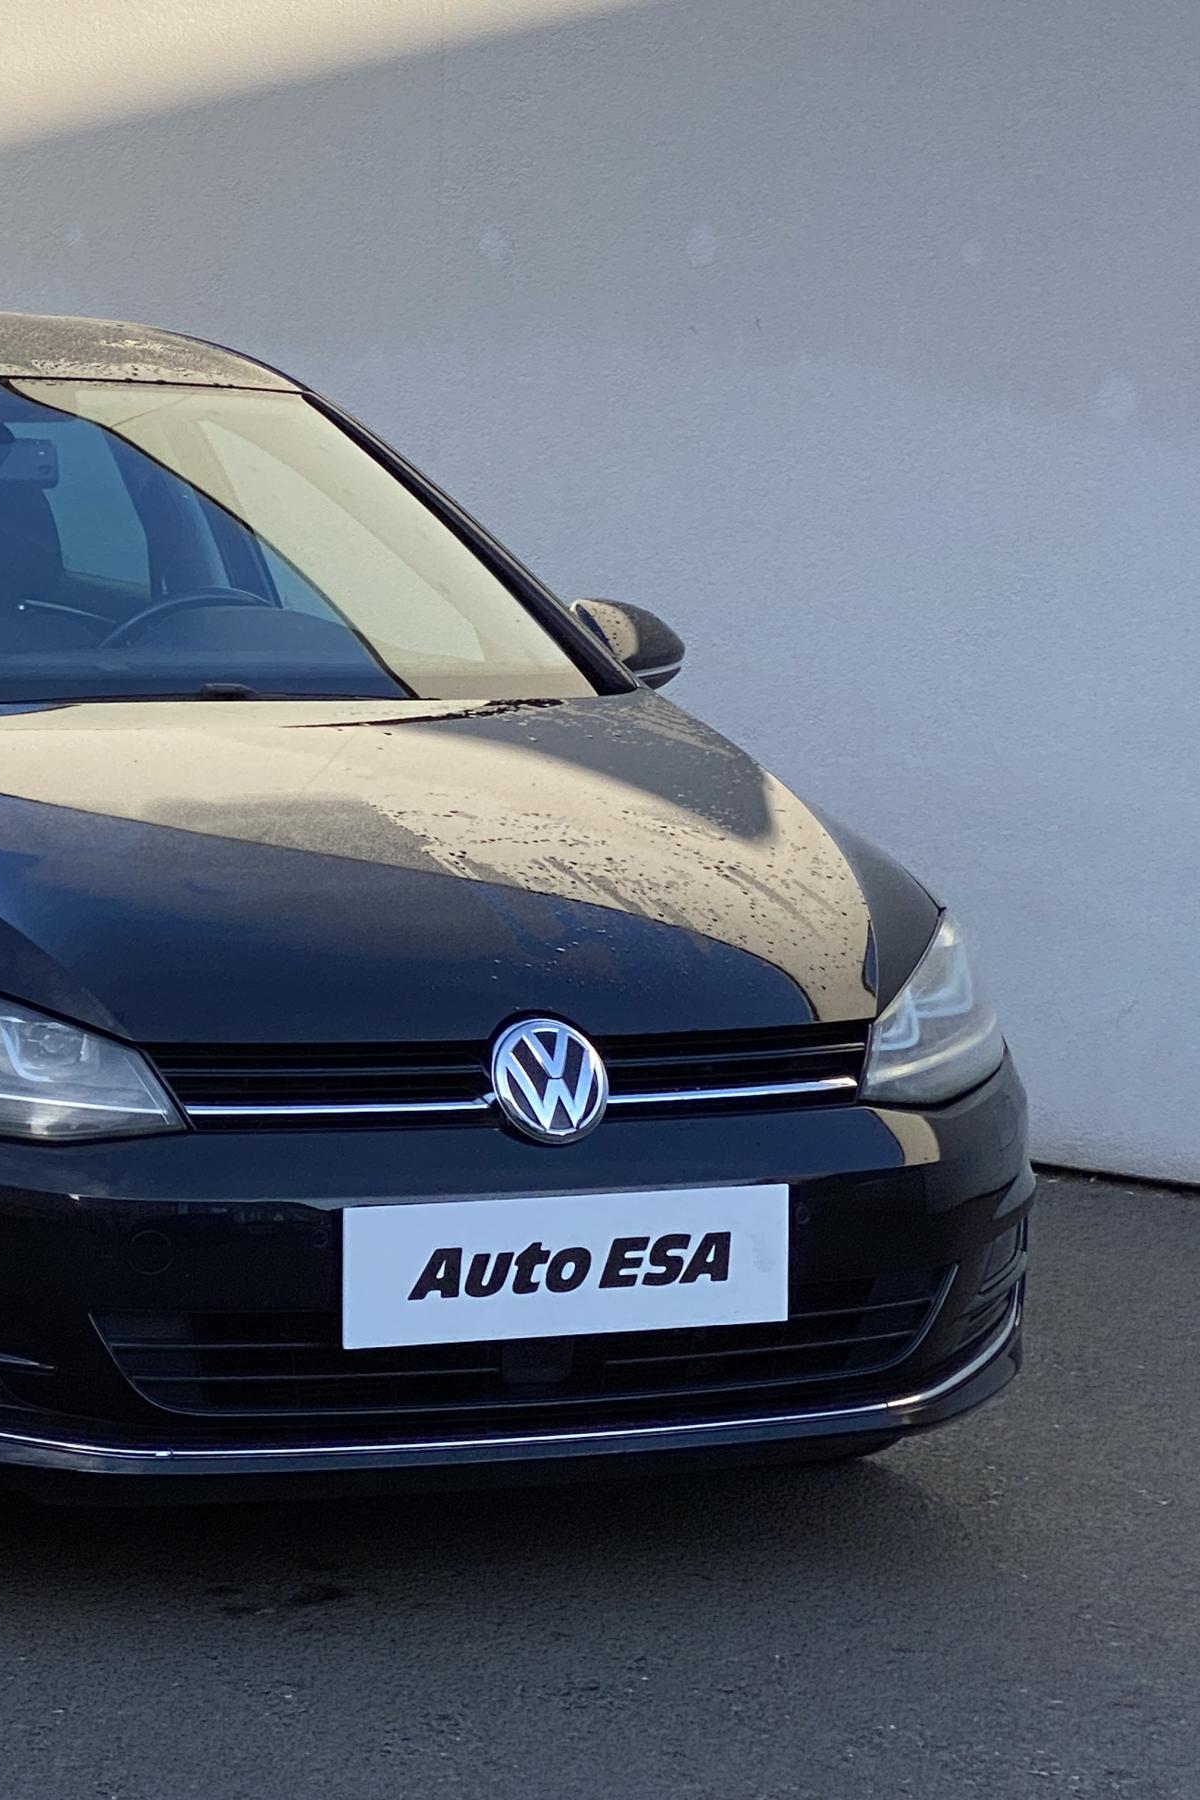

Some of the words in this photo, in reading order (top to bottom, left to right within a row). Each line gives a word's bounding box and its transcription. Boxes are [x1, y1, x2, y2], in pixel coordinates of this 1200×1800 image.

[496, 1022, 606, 1136] VW
[408, 1242, 591, 1301] Auto
[599, 1231, 732, 1288] ESA
